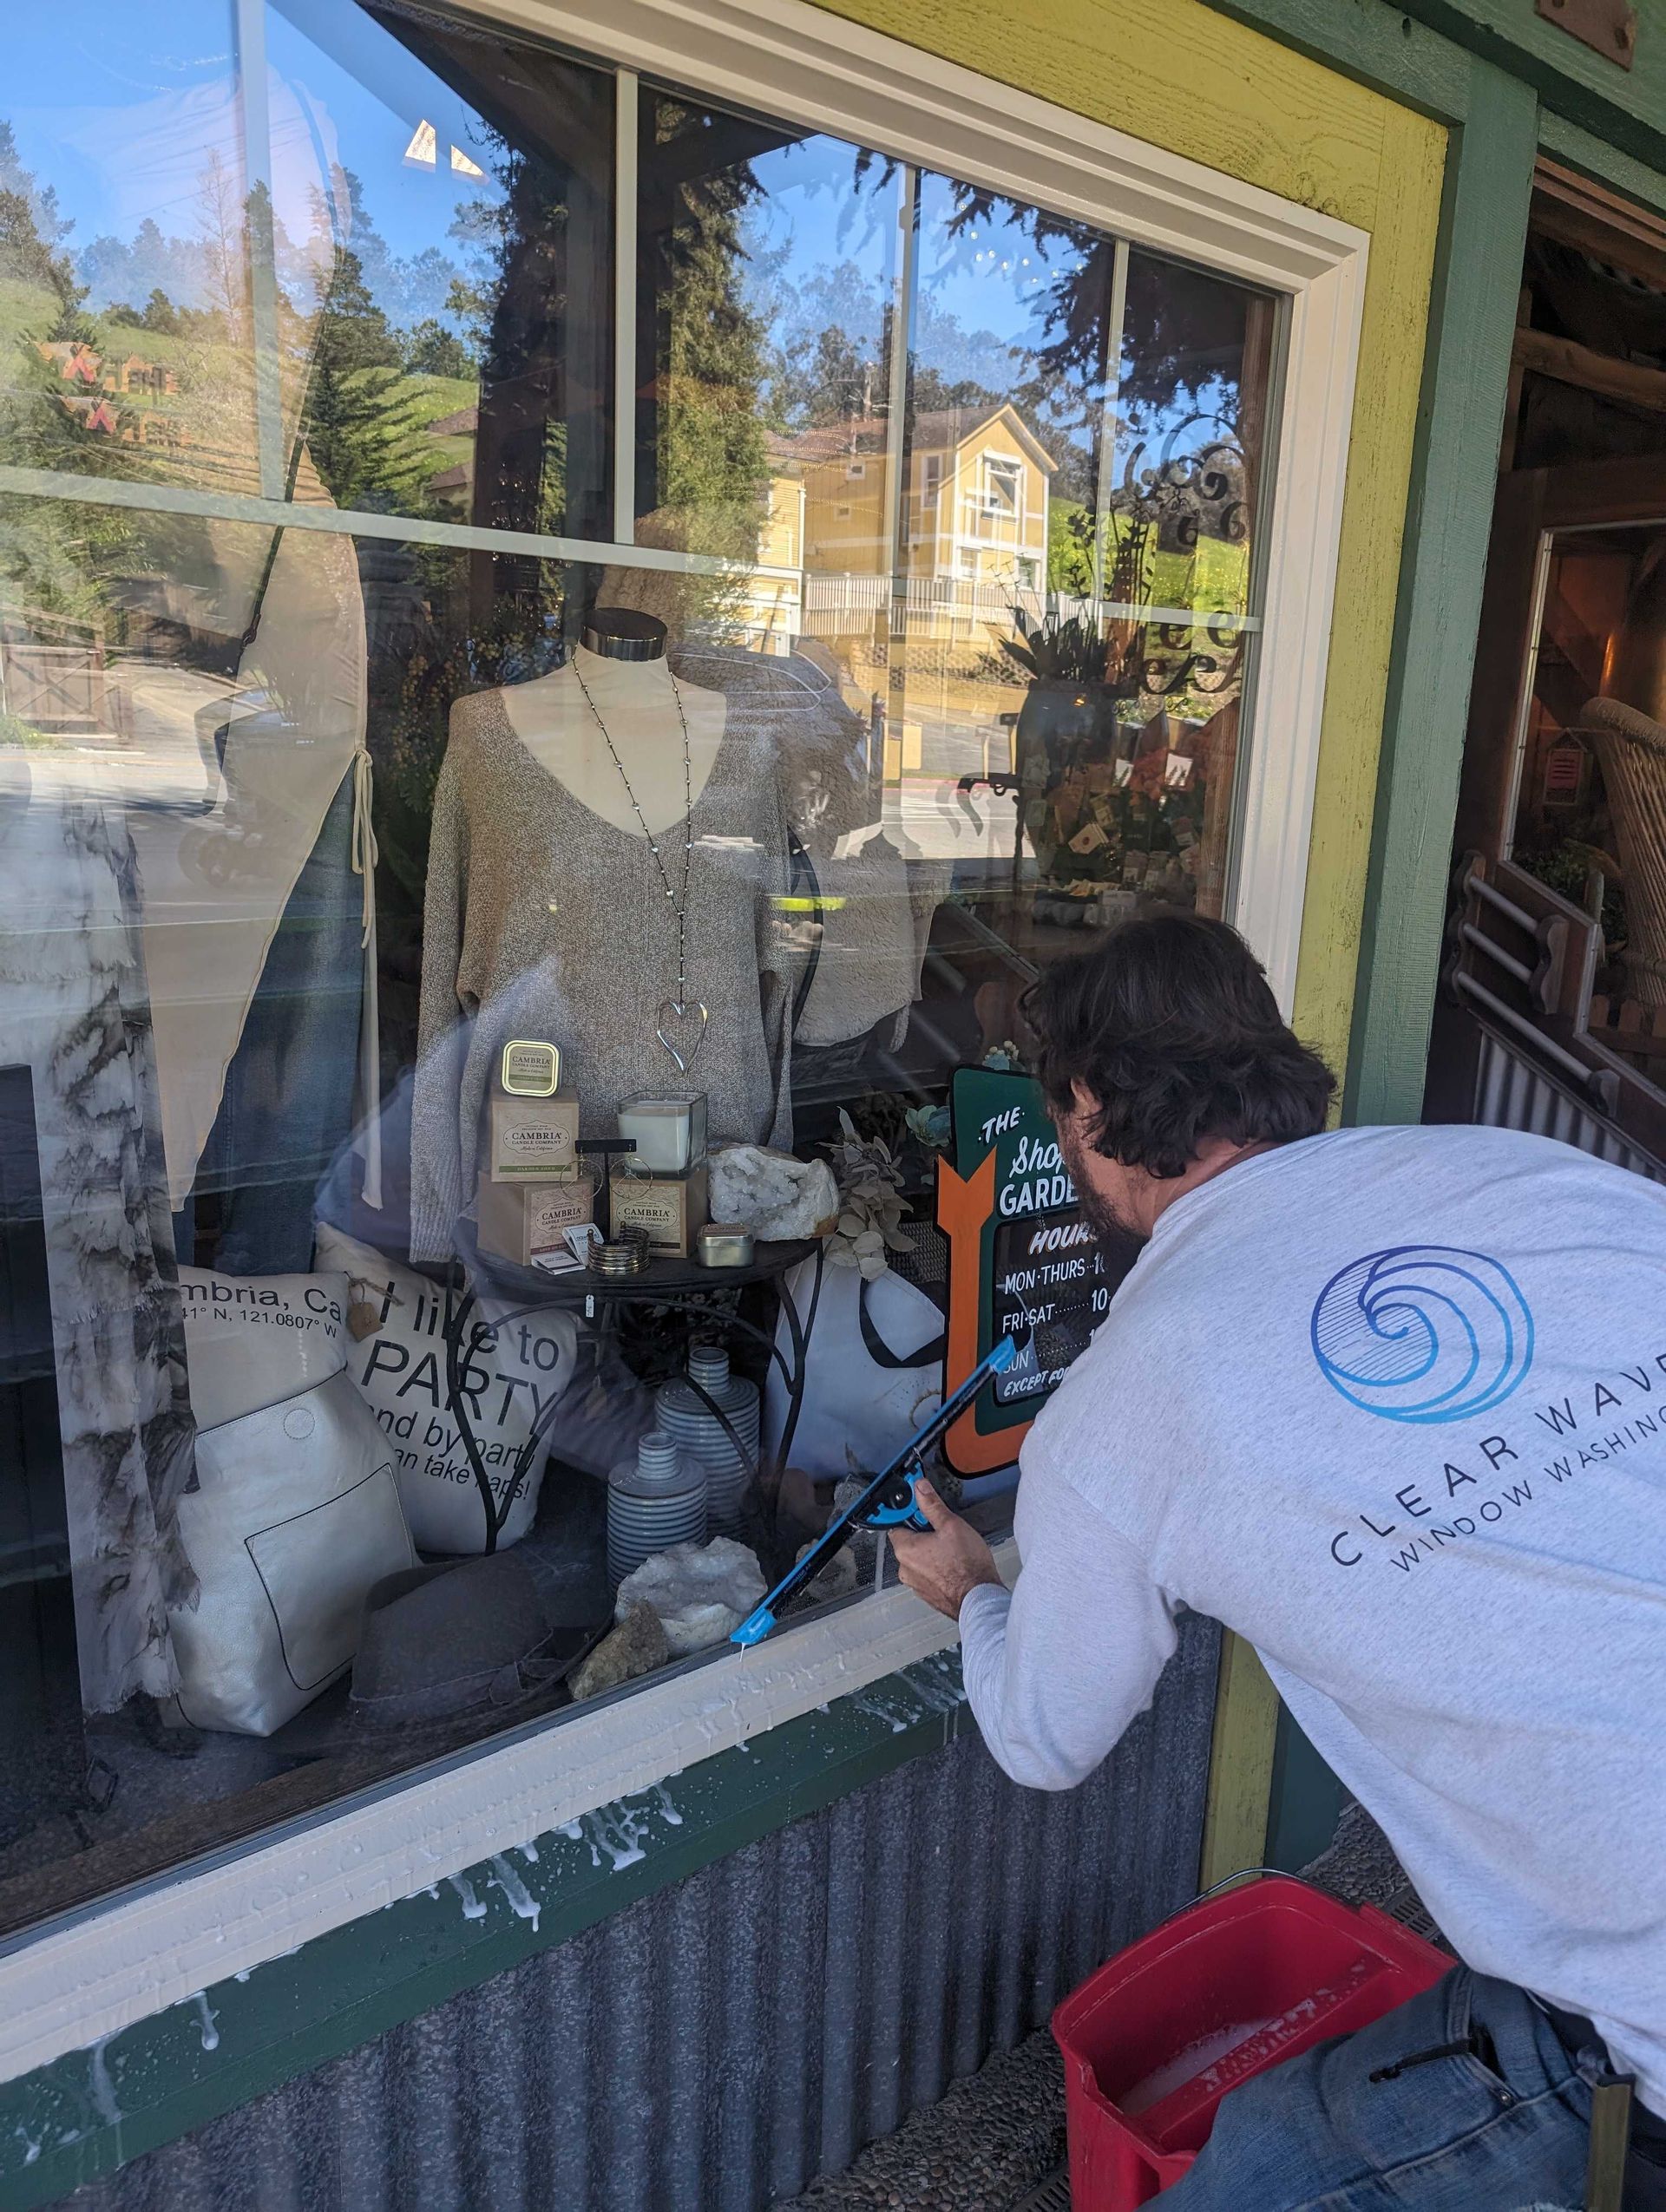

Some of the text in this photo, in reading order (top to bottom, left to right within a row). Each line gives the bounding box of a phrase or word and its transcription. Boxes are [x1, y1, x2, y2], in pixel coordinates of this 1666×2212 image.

[981, 1106, 1021, 1143] THE
[1028, 1221, 1098, 1255] HOUR
[213, 1307, 233, 1322] N,
[239, 1310, 319, 1330] 121.0807°
[324, 1323, 337, 1338] W
[304, 1288, 342, 1325] Ca
[379, 1281, 395, 1324] I
[517, 1325, 560, 1371] to
[360, 1338, 559, 1436] PARTY
[1003, 1370, 1048, 1397] EXCEPT
[369, 1404, 418, 1440] nd
[423, 1417, 463, 1458] by
[423, 1456, 470, 1485] take
[1330, 1436, 1518, 1567] CLEAR
[1390, 1480, 1532, 1572] WINDOW
